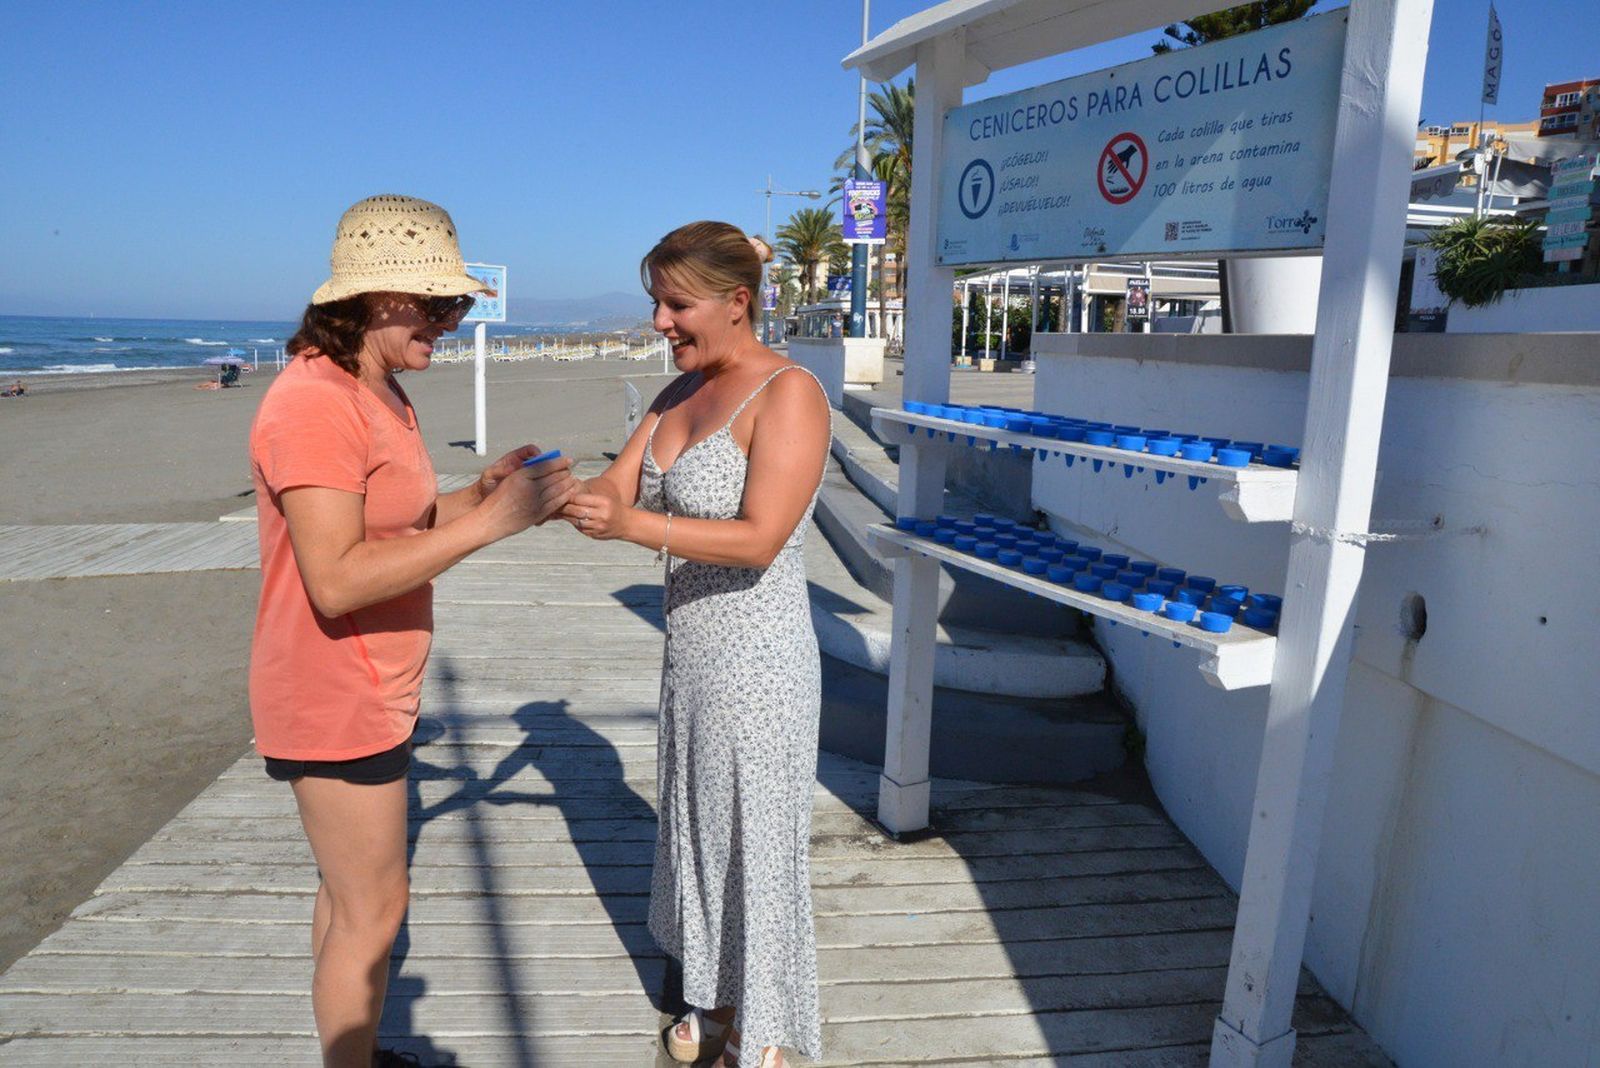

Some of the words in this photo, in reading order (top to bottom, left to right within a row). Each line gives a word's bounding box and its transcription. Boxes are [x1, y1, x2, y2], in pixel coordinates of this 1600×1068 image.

[969, 96, 1079, 141] CENICEROS
[1087, 82, 1143, 118] PARA
[1154, 47, 1292, 103] COLILLAS
[1158, 126, 1185, 143] Cada
[1190, 119, 1225, 138] colilla
[1230, 119, 1254, 134] que
[1261, 111, 1294, 127] tiras
[1155, 159, 1169, 171] en
[1174, 153, 1185, 168] la
[1190, 151, 1224, 166] arena
[1229, 139, 1301, 161] contamina
[1153, 182, 1177, 197] 100
[1181, 180, 1214, 195] litros
[1220, 176, 1235, 190] de
[1241, 175, 1272, 192] agua
